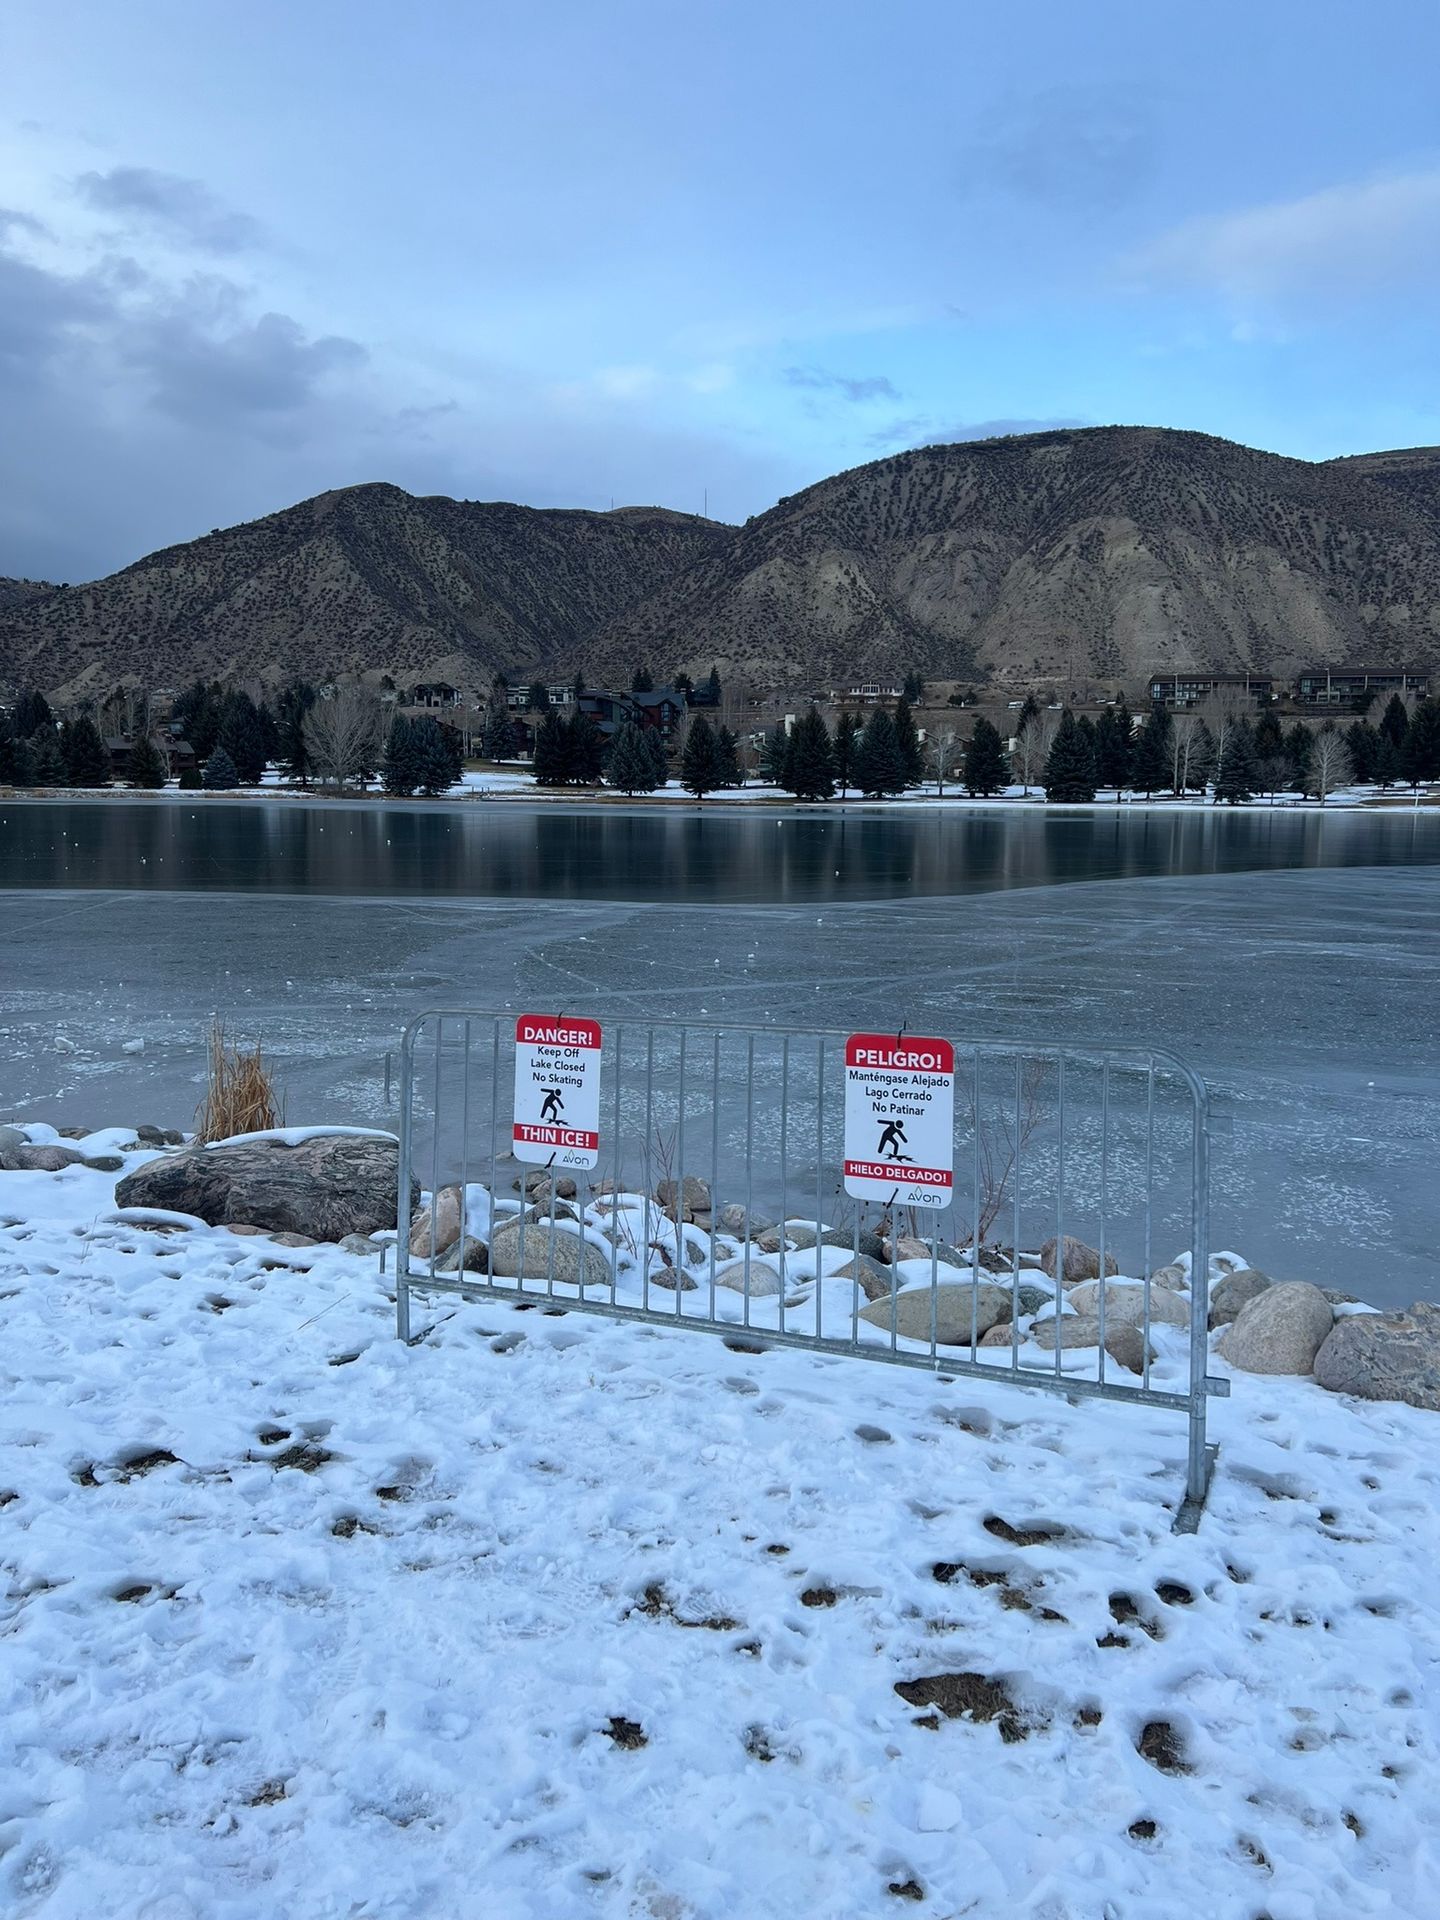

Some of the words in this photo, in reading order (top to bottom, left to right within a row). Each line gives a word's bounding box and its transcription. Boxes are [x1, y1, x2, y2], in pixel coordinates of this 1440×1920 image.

[525, 1027, 592, 1045] DANGER!
[538, 1046, 561, 1058] Keep
[564, 1048, 579, 1057] Off
[856, 1049, 941, 1069] PELIGRO!
[531, 1059, 551, 1069] Lake
[554, 1061, 585, 1072] Closed
[533, 1073, 546, 1081] No
[549, 1074, 582, 1087] Skating
[849, 1070, 908, 1085] Manténgase
[912, 1075, 949, 1089] Alejado
[866, 1087, 888, 1100] Lago
[892, 1089, 932, 1101] Cerrado
[873, 1102, 887, 1112] No
[890, 1104, 925, 1116] Patinar
[521, 1126, 556, 1143] THIN
[561, 1132, 589, 1146] ICE!
[850, 1164, 882, 1176] HIELO
[886, 1167, 946, 1182] DELGADO!
